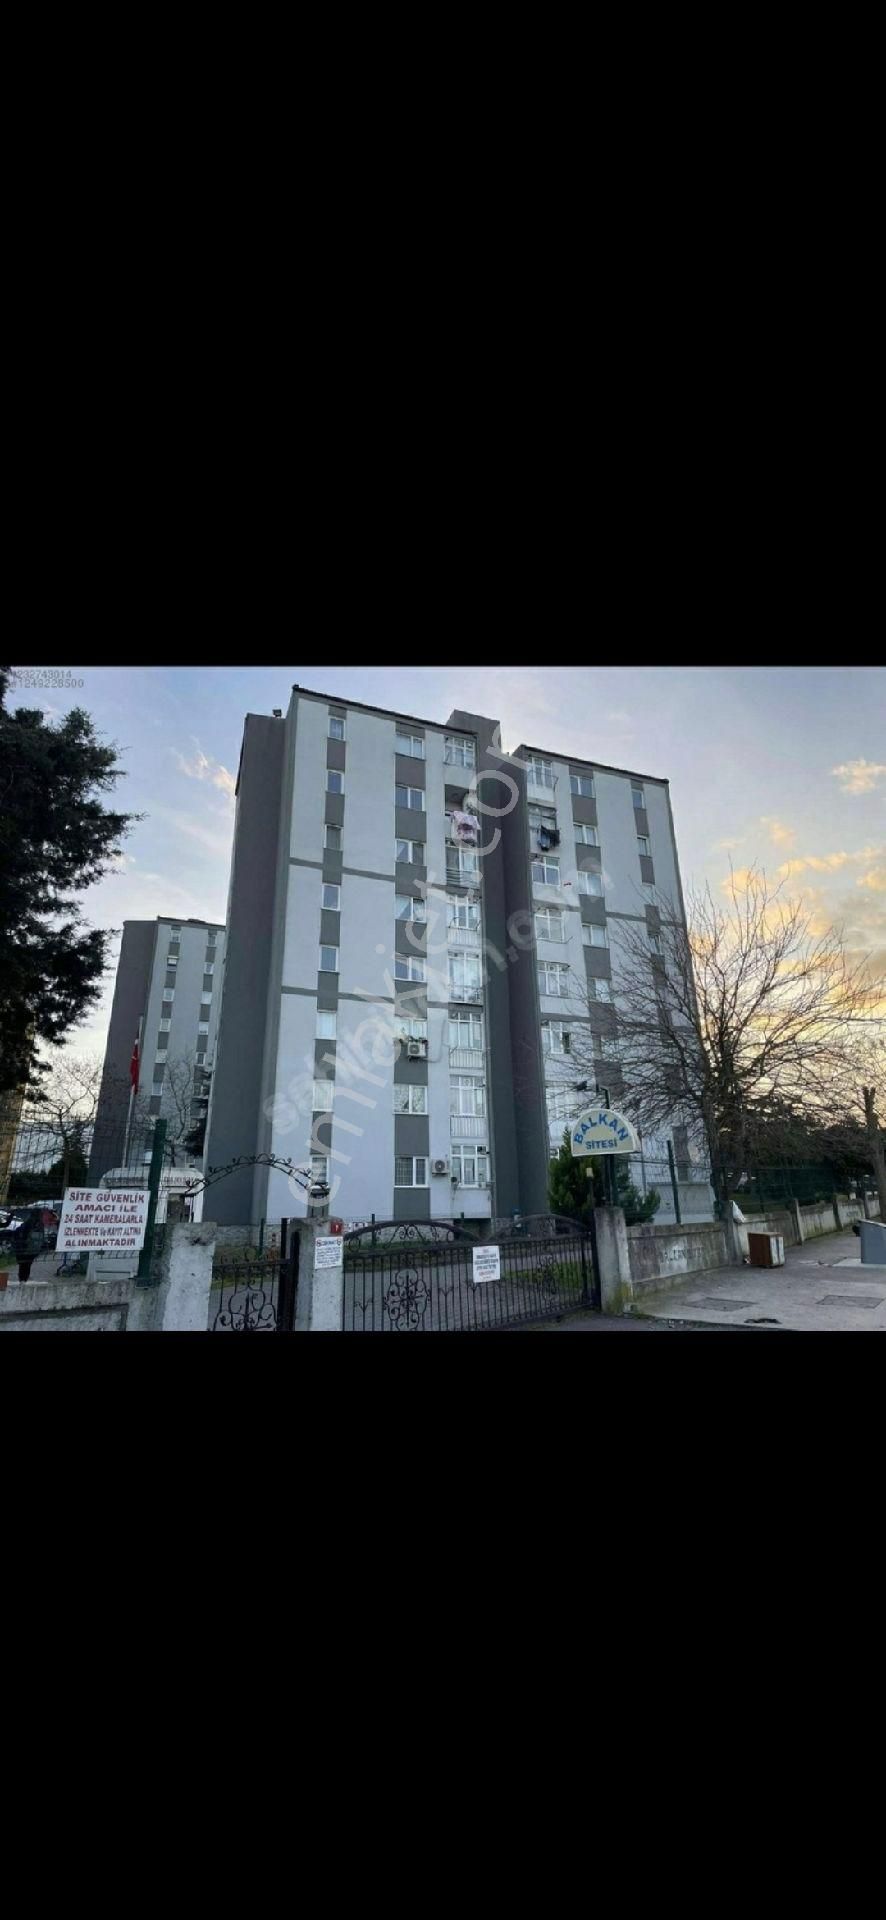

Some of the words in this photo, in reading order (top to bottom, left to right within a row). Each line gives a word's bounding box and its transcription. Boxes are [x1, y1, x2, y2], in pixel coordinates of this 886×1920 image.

[574, 1113, 629, 1144] BALKAN
[585, 1137, 617, 1150] SİTESİ
[69, 1191, 92, 1202] SİTE
[96, 1191, 145, 1204] GÜVENLİK
[74, 1204, 115, 1212] AMACI
[119, 1204, 138, 1213] İLE
[64, 1214, 73, 1224] 24
[74, 1214, 93, 1223] SAAT
[94, 1214, 143, 1224] KAMERALARLA
[65, 1238, 136, 1247] ALINMAKTADIR
